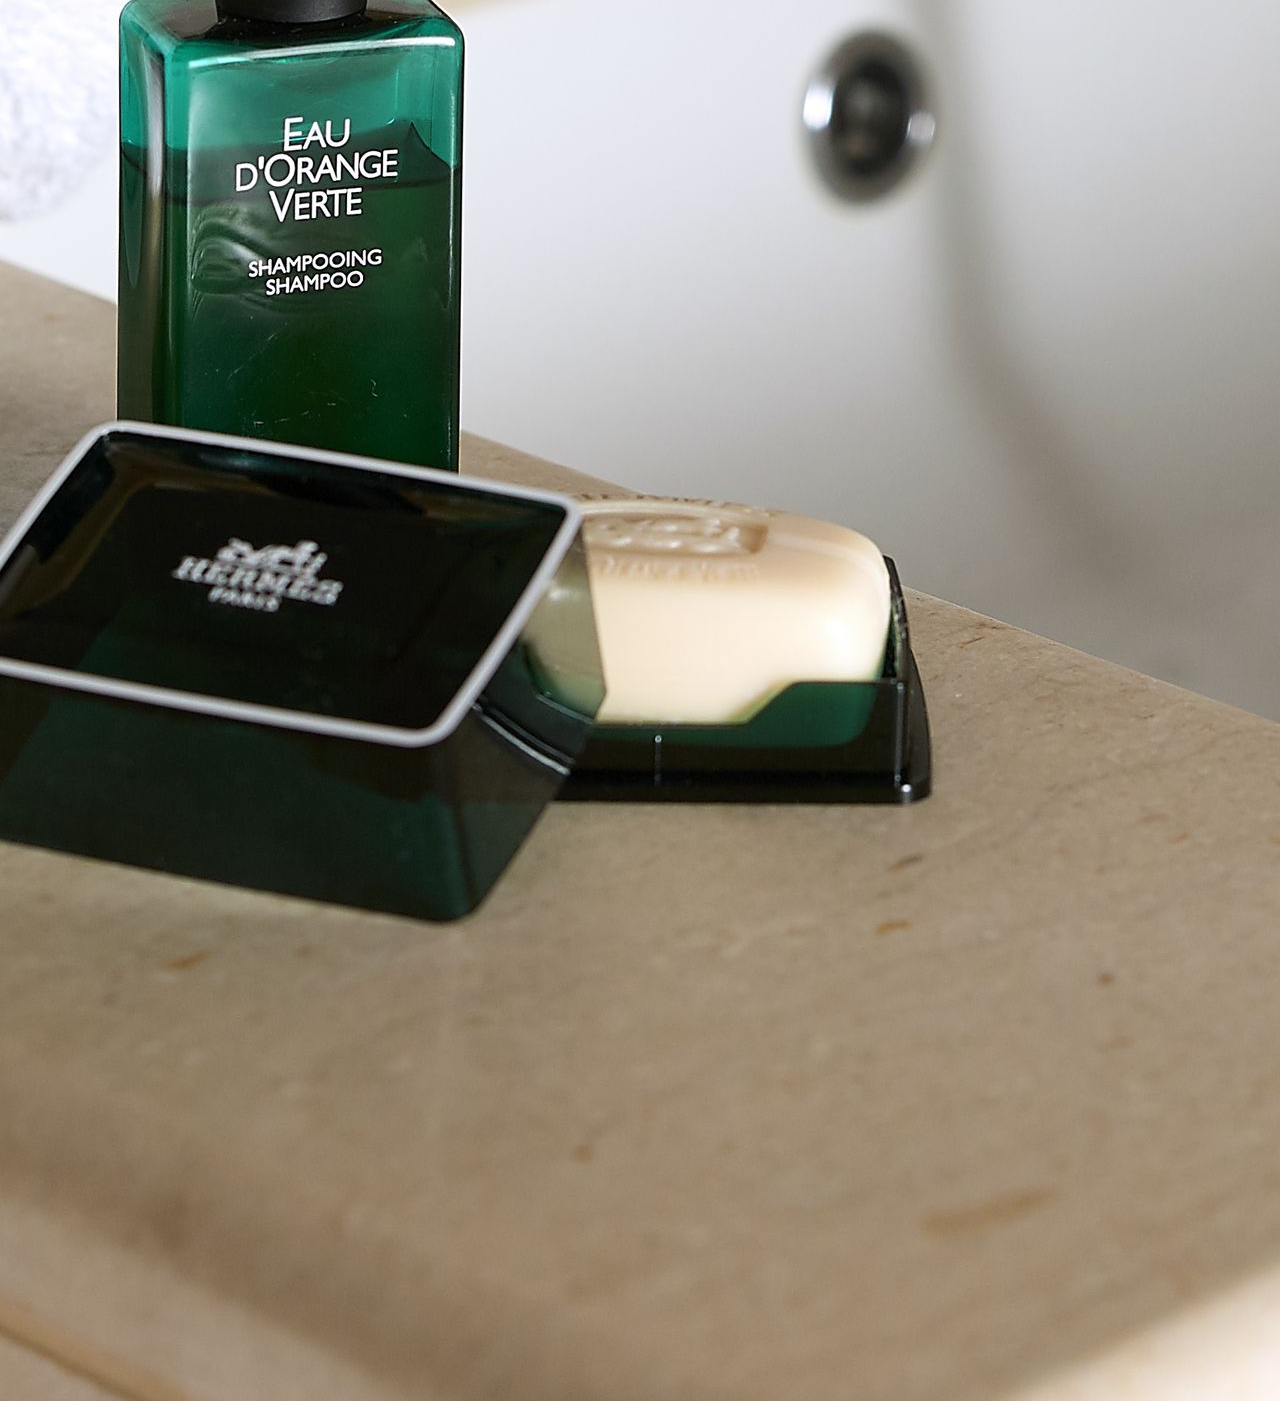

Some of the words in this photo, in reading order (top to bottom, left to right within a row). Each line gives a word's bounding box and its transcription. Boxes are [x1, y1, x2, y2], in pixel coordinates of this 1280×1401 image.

[283, 116, 351, 152] EAU
[235, 149, 399, 192] D'ORANGE
[268, 187, 363, 223] VERTE
[248, 248, 382, 278] SHAMPOOING
[265, 270, 364, 296] SHAMPOO
